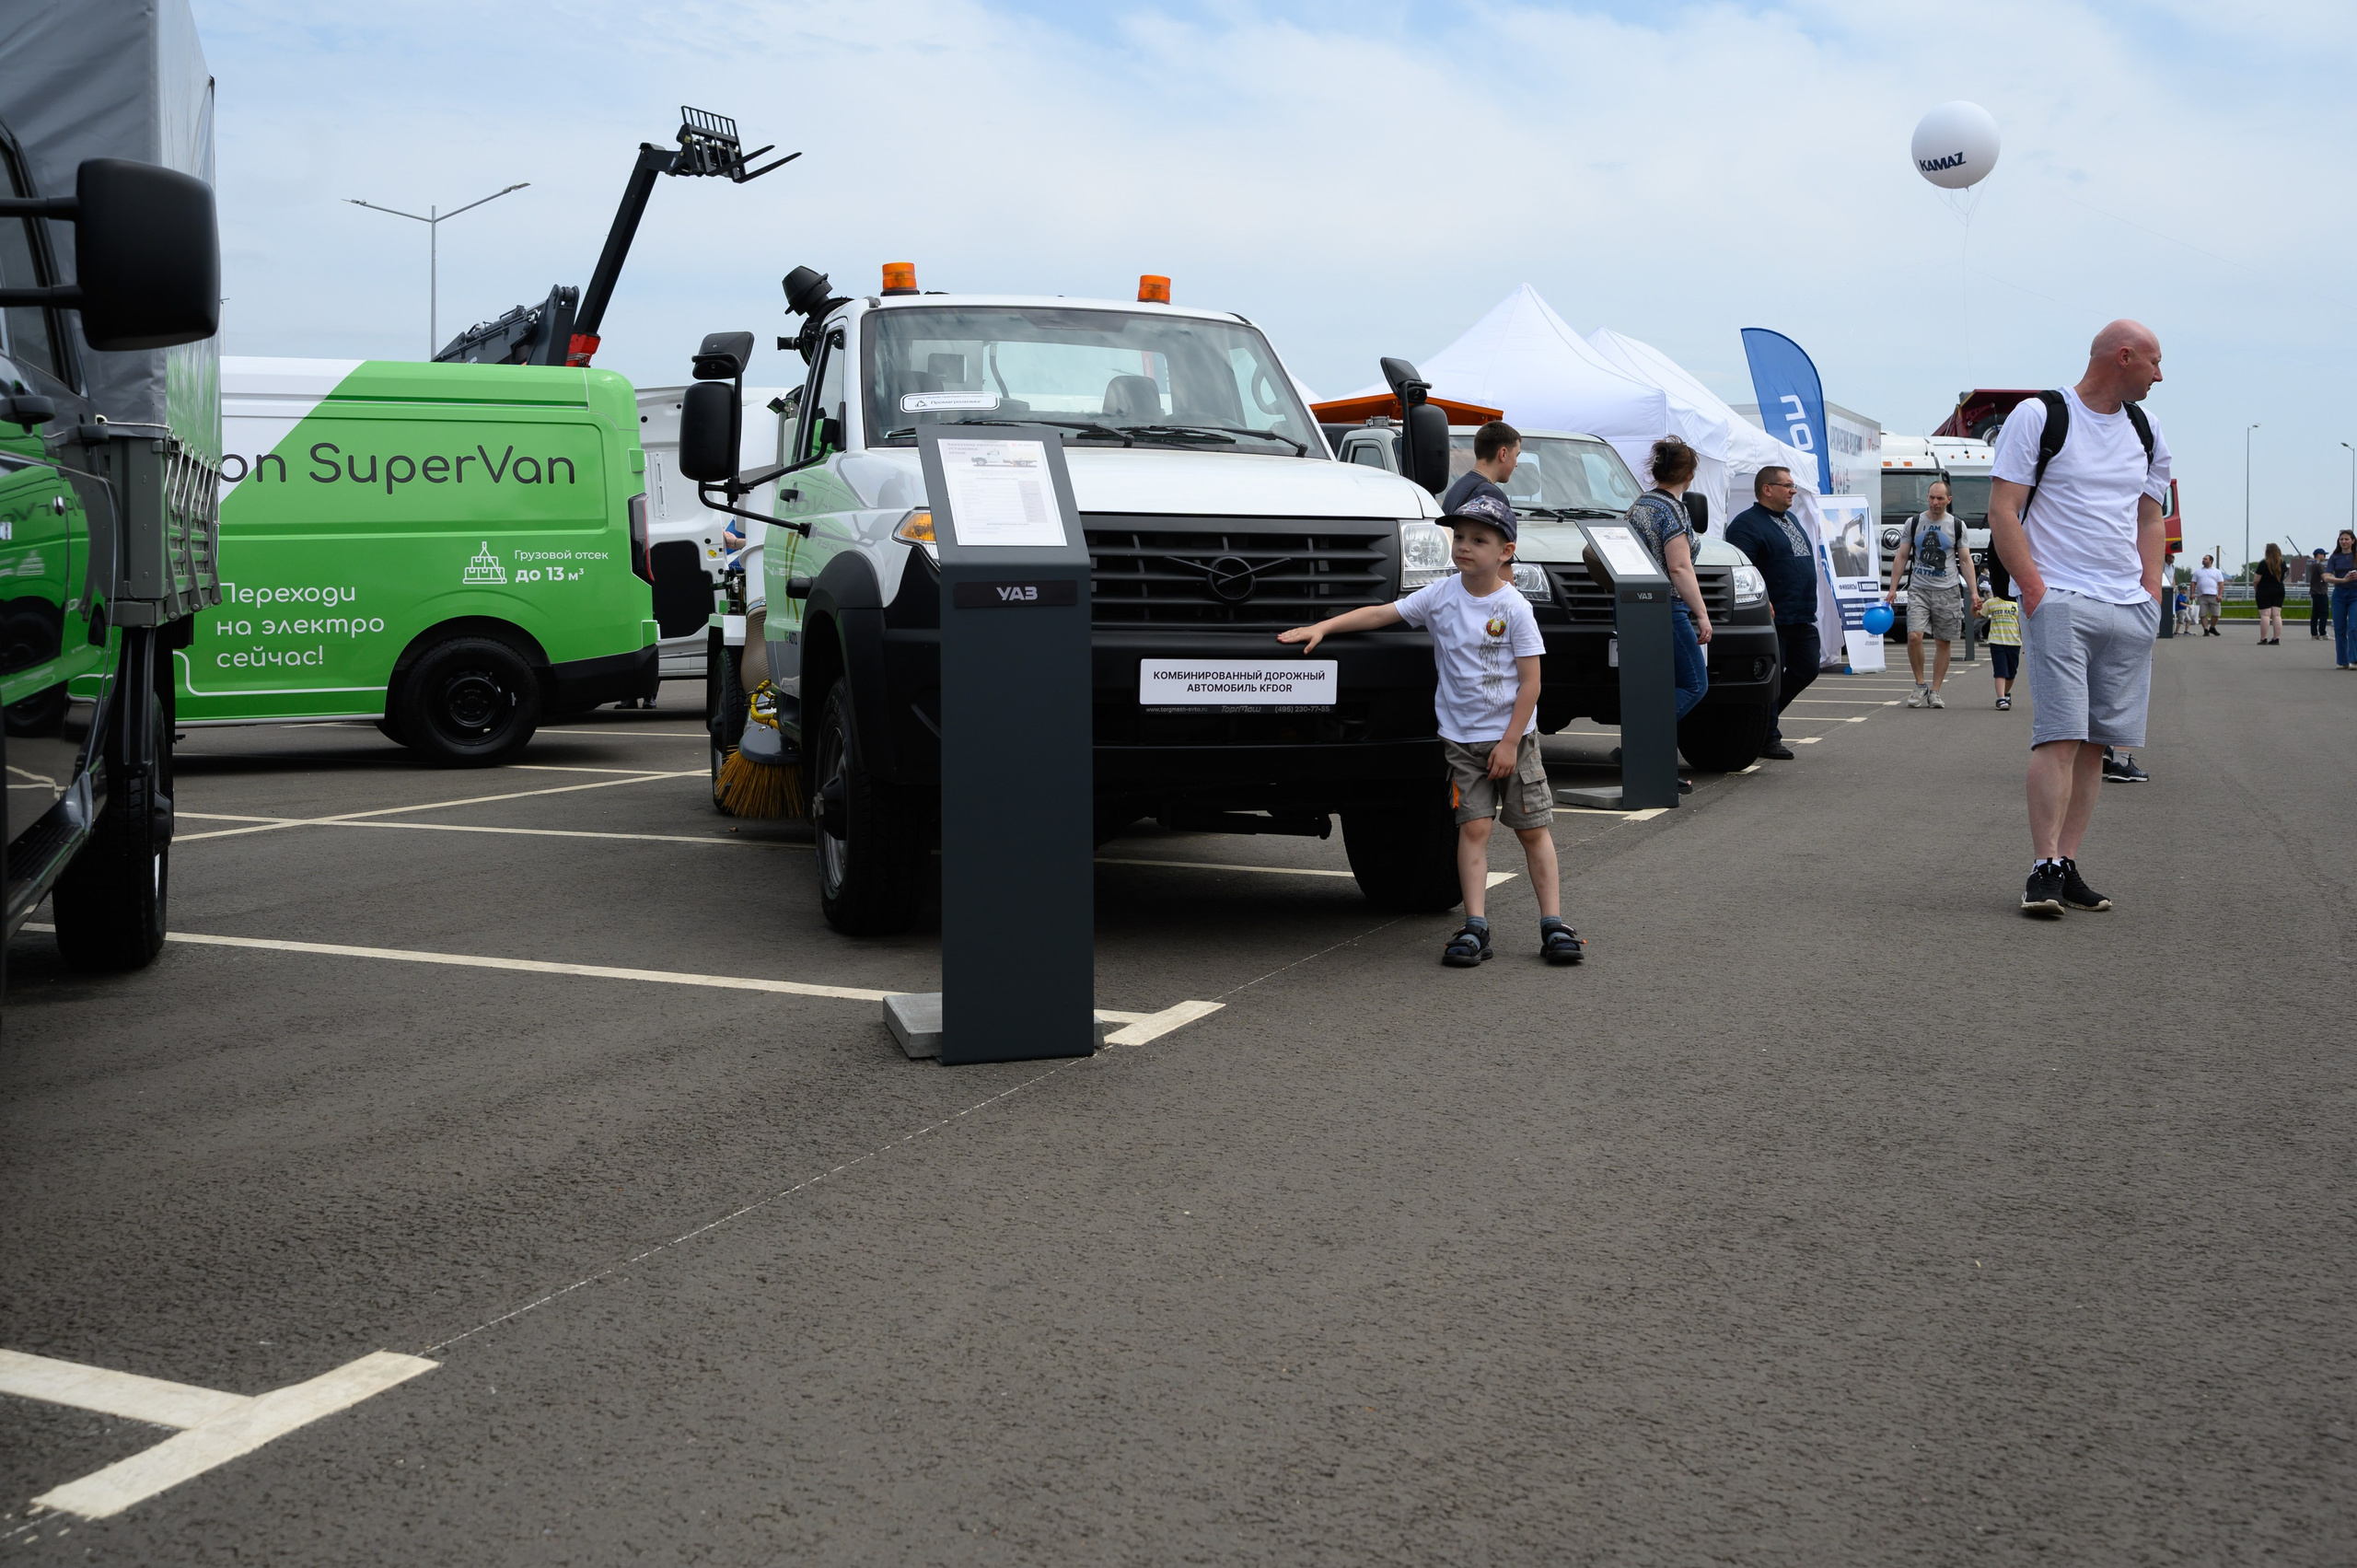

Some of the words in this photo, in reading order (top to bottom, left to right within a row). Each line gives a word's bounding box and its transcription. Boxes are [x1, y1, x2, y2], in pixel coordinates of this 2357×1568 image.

[1919, 151, 1967, 172] KAMAZ
[220, 453, 286, 483] on
[309, 442, 575, 495] SuperVan
[514, 550, 572, 562] Грузовой
[575, 552, 609, 560] отсек
[515, 569, 541, 583] до
[545, 566, 565, 581] 13
[1913, 567, 1947, 577] FATHER
[219, 582, 356, 609] Переходи
[995, 587, 1038, 601] УАЗ
[216, 621, 252, 636] на
[261, 616, 385, 638] электро
[216, 645, 324, 668] сейчас!
[1153, 669, 1262, 680] КОМБИНИРОВАННЫЙ
[1264, 670, 1326, 681] ДОРОЖНЫЙ
[1187, 684, 1258, 692] АВТОМОБИЛЬ
[1260, 684, 1293, 692] KFDOR
[1274, 705, 1294, 714] (495)
